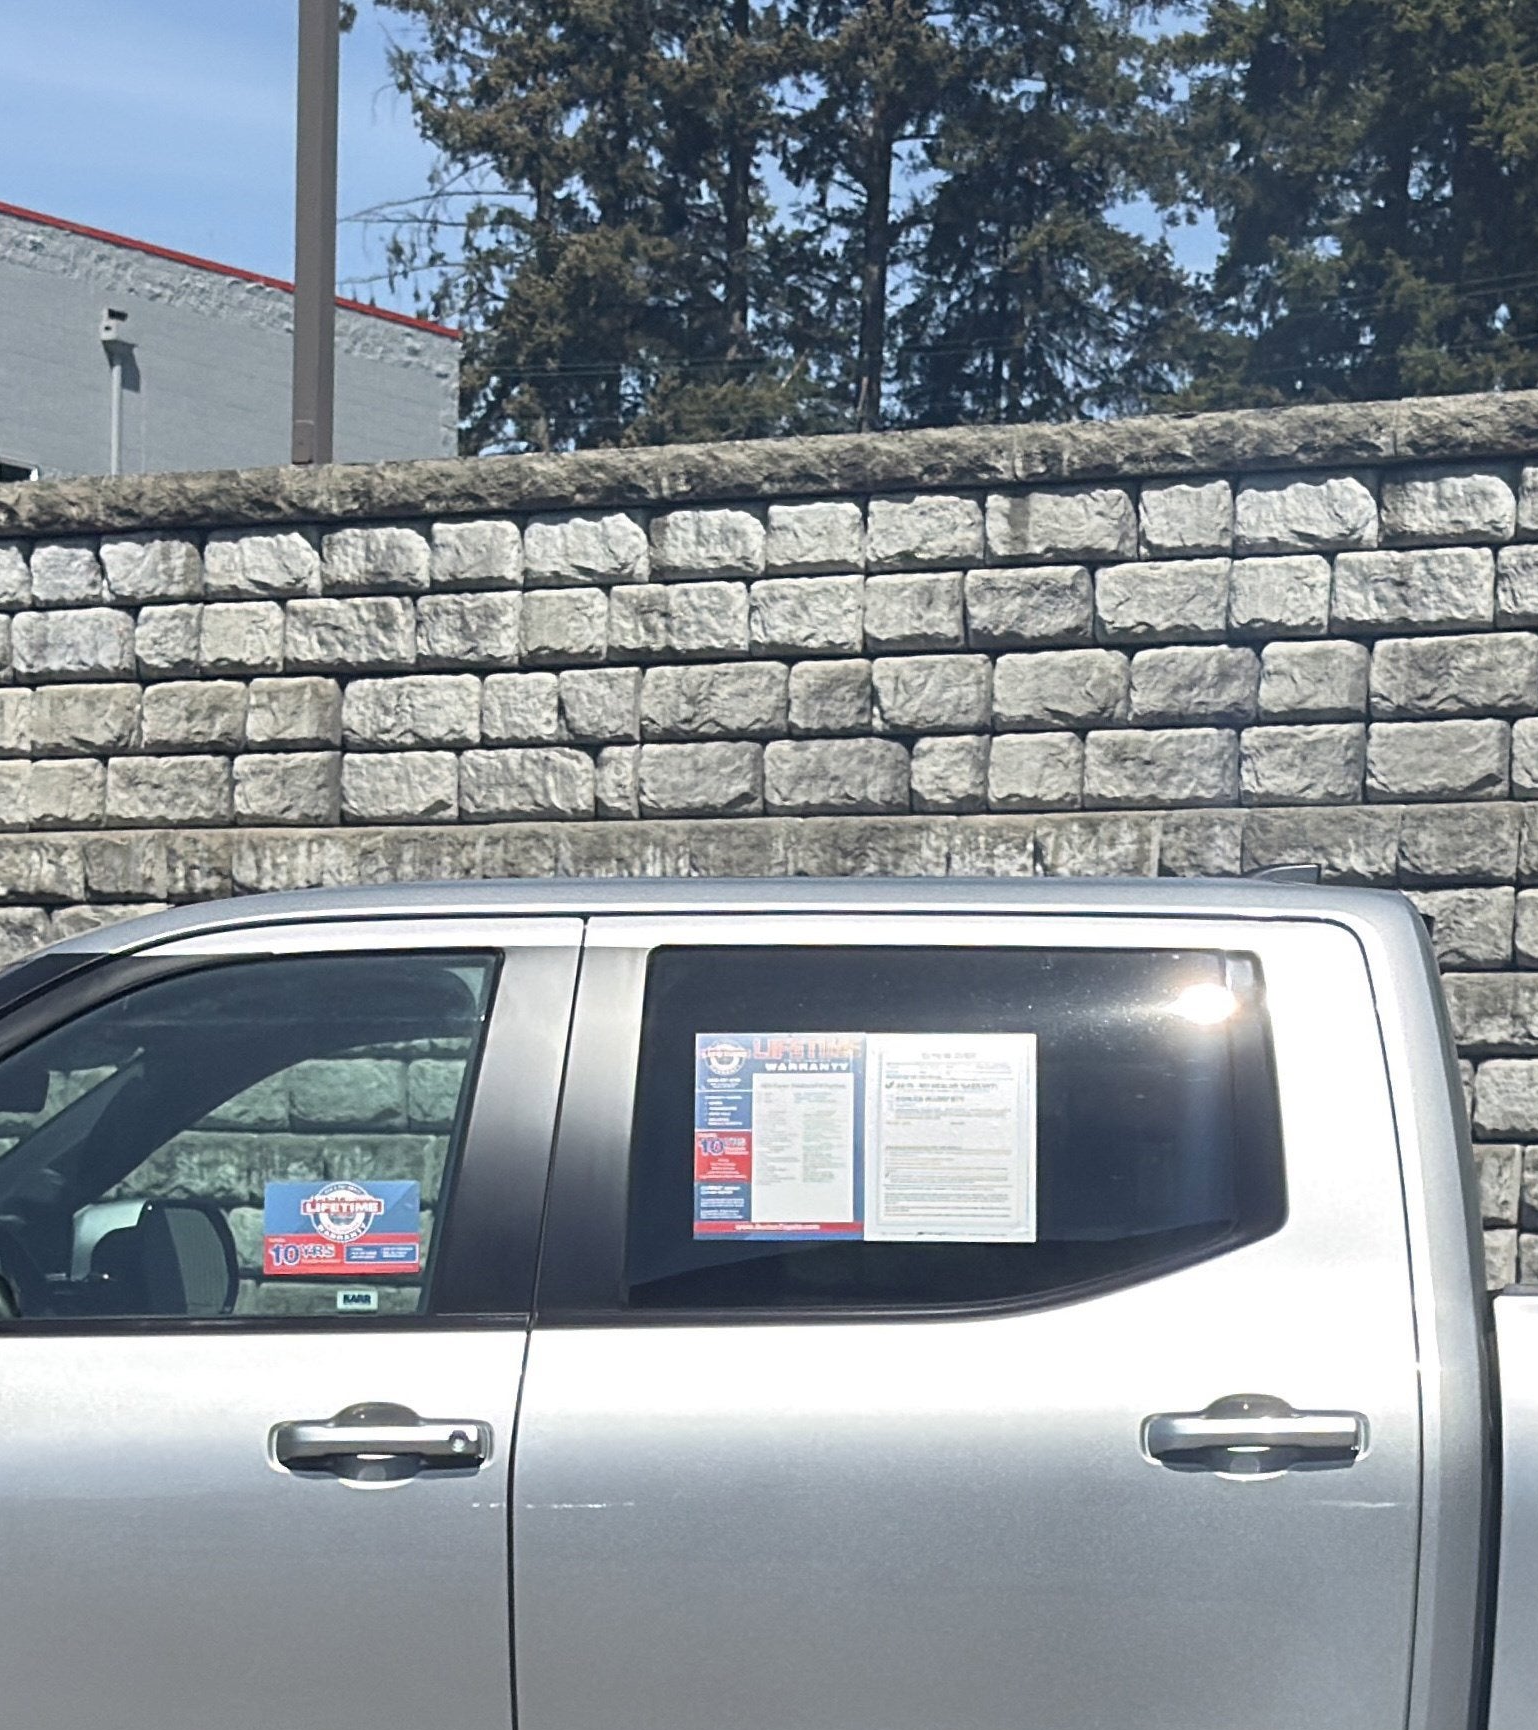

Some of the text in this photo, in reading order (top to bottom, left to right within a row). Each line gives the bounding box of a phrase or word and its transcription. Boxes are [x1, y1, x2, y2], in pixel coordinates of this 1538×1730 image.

[765, 1063, 850, 1071] WARRANTY
[306, 1202, 379, 1213] LIFETIME
[269, 1244, 300, 1266] 10
